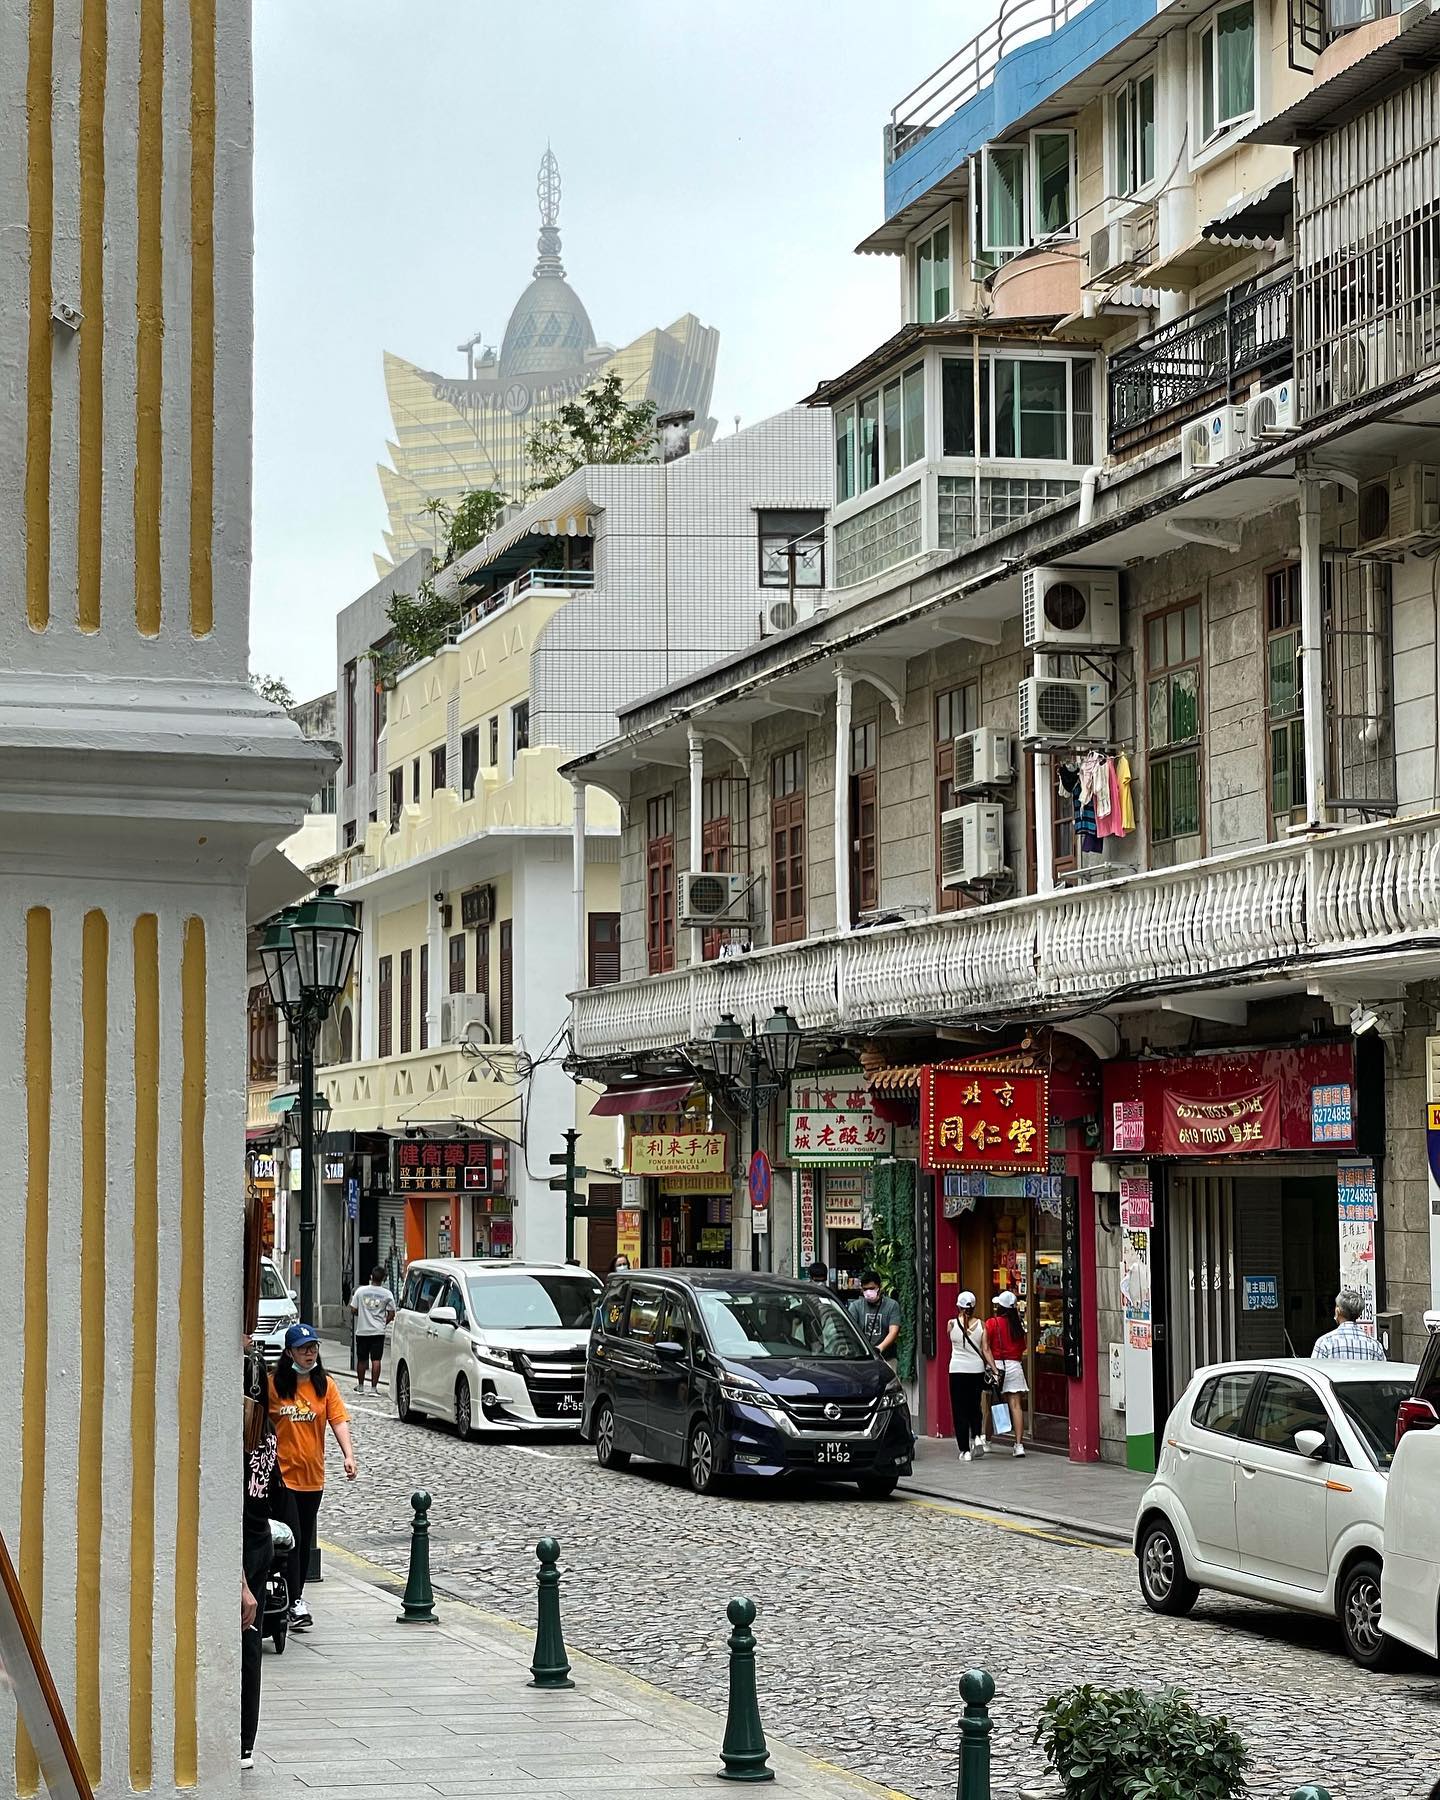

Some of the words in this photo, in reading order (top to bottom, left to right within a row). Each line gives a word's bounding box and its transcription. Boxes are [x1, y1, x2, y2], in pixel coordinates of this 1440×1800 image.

[962, 1081, 1014, 1106] 北京
[1202, 1105, 1228, 1119] 1853
[1314, 1107, 1350, 1122] 62724855
[817, 1124, 886, 1146] 老酸奶
[940, 1116, 1037, 1153] 同仁堂
[1200, 1128, 1226, 1143] 7050
[1228, 1120, 1263, 1143] 曾先生
[564, 1395, 575, 1403] ML
[827, 1443, 841, 1453] MY
[818, 1453, 850, 1463] 21-62
